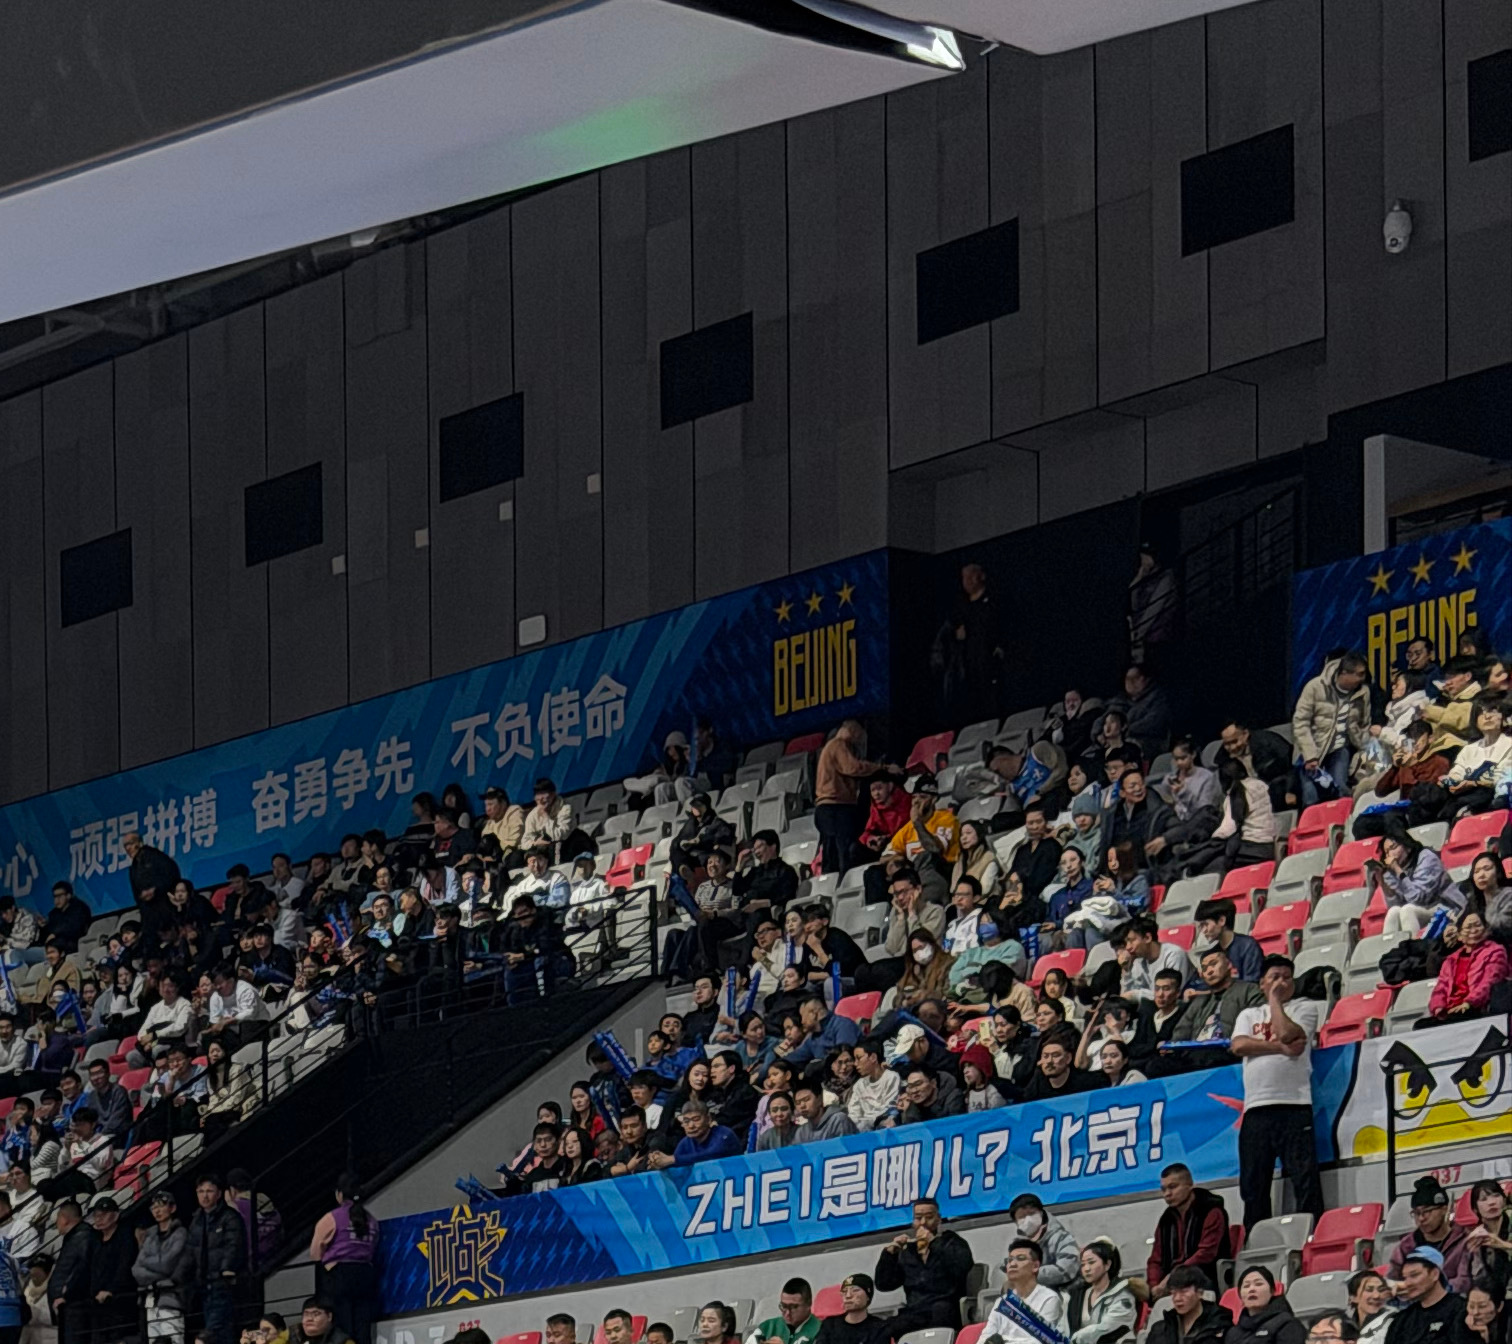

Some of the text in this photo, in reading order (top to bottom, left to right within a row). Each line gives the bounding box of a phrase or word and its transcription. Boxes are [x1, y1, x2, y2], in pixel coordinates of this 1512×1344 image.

[773, 618, 857, 717] BEIJING
[69, 787, 219, 882] 顽强拼搏
[251, 735, 414, 834] 奋勇争先
[451, 673, 628, 777] 不负使命
